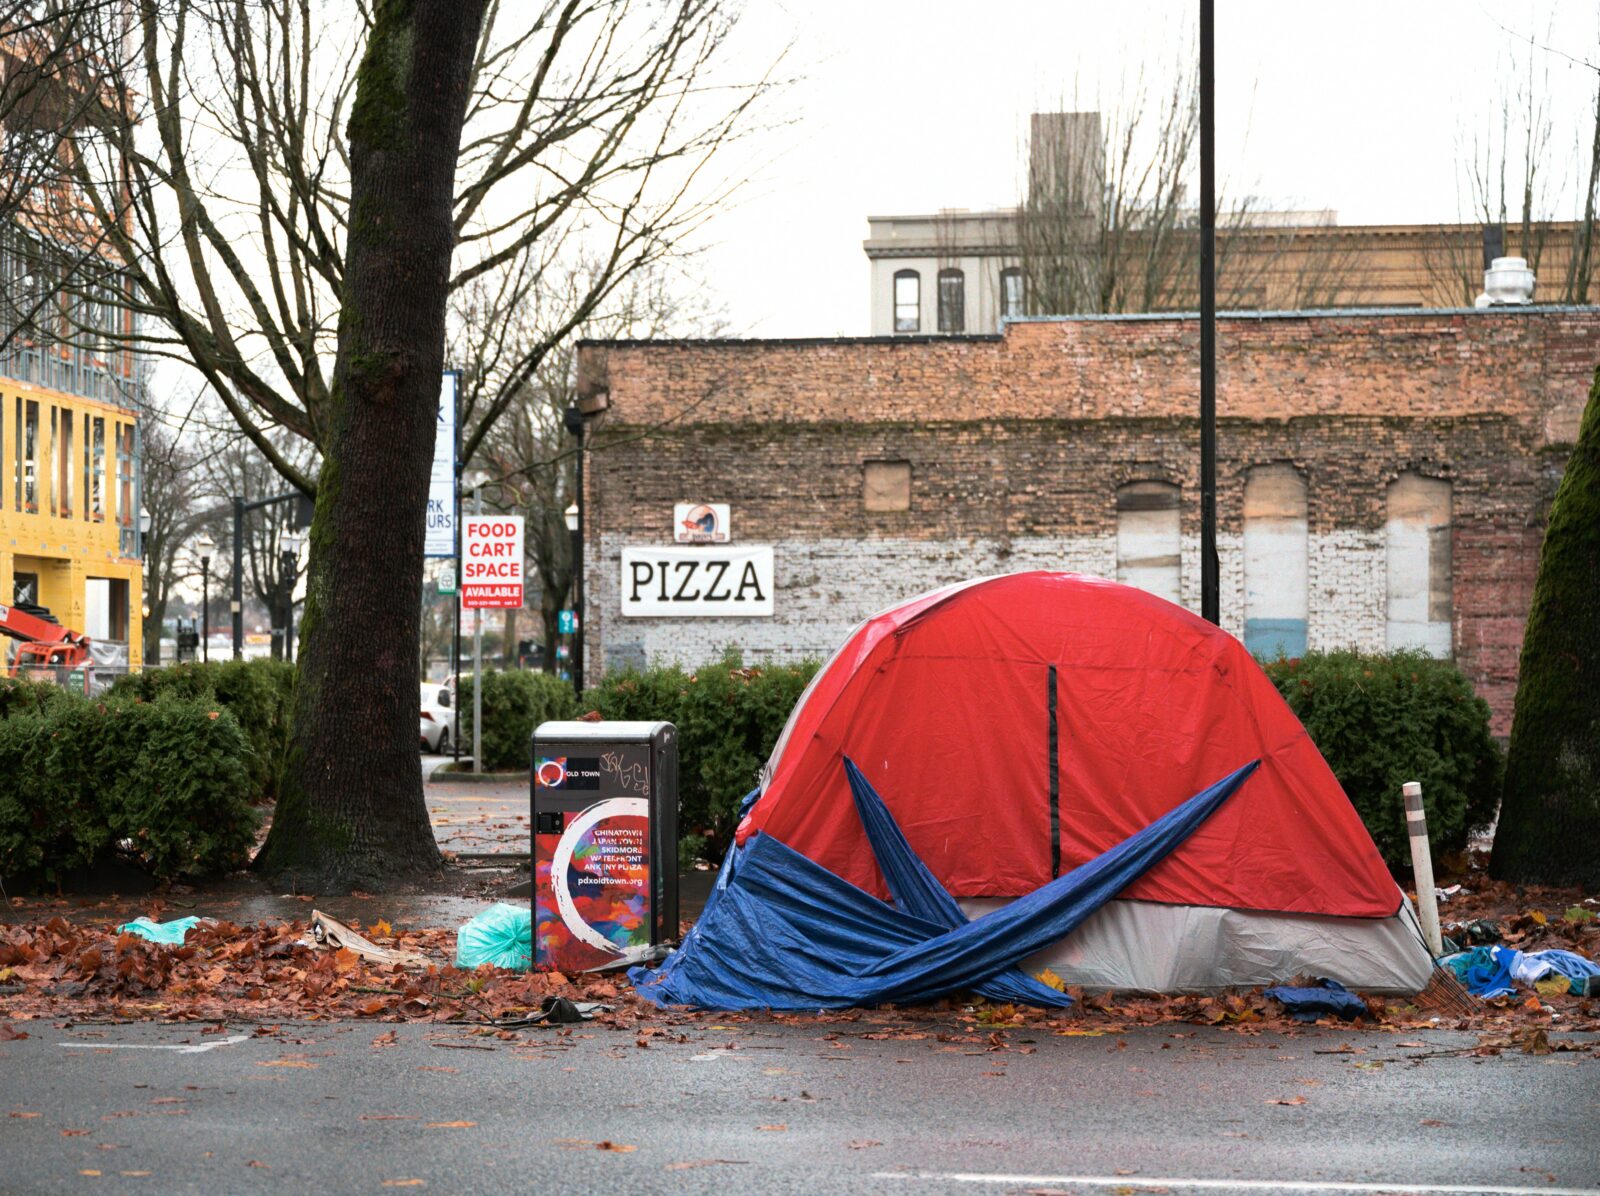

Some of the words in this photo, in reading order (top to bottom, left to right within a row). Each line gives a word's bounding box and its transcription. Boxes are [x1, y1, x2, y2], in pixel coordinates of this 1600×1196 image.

[427, 499, 443, 512] RK
[427, 514, 451, 528] URS
[468, 523, 517, 537] FOOD
[469, 543, 515, 557] CART
[465, 563, 520, 578] SPACE
[629, 561, 766, 602] PIZZA
[465, 586, 520, 597] AVAILABLE
[578, 876, 643, 887] pdxoldtown.org
